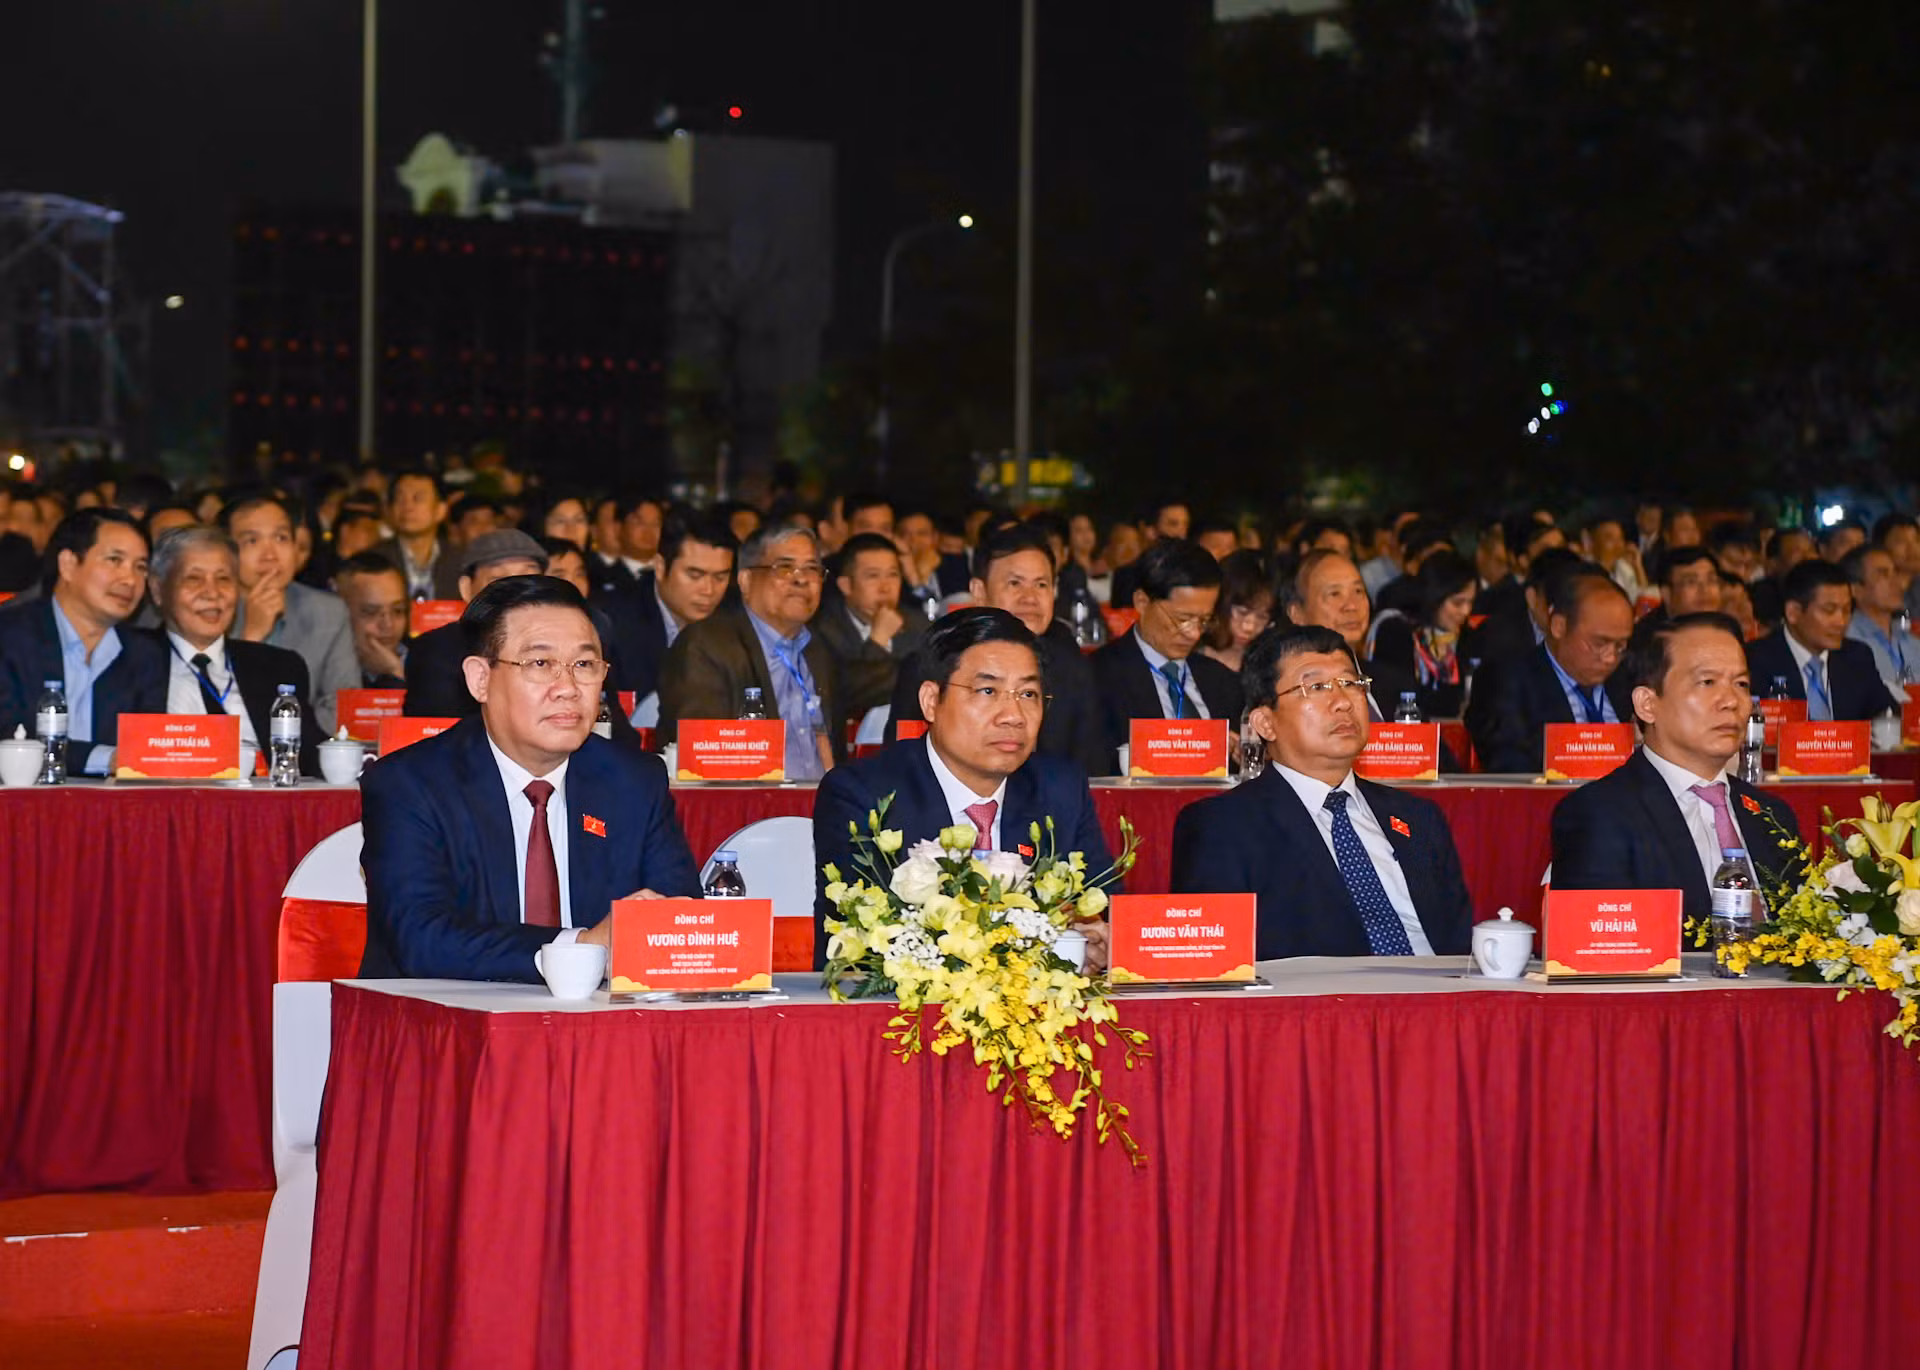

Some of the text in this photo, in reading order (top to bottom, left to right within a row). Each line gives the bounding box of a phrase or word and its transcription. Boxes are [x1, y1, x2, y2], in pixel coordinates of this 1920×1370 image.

[148, 736, 210, 748] PHẠM THÁI HÀ
[693, 740, 769, 750] HOÀNG THANH KHIẾT
[1148, 740, 1171, 749] DƯƠNG
[1172, 739, 1187, 749] VĂN
[1166, 907, 1202, 918] ĐỒNG CHÍ
[1598, 902, 1632, 912] ĐỒNG CHÍ
[674, 913, 714, 924] ĐỒNG CHÍ
[1590, 918, 1637, 932] VŨ HẢI HÀ
[1141, 924, 1224, 938] DƯƠNG VĂN THÁI
[647, 930, 739, 947] VƯƠNG ĐÌNH HUỆ
